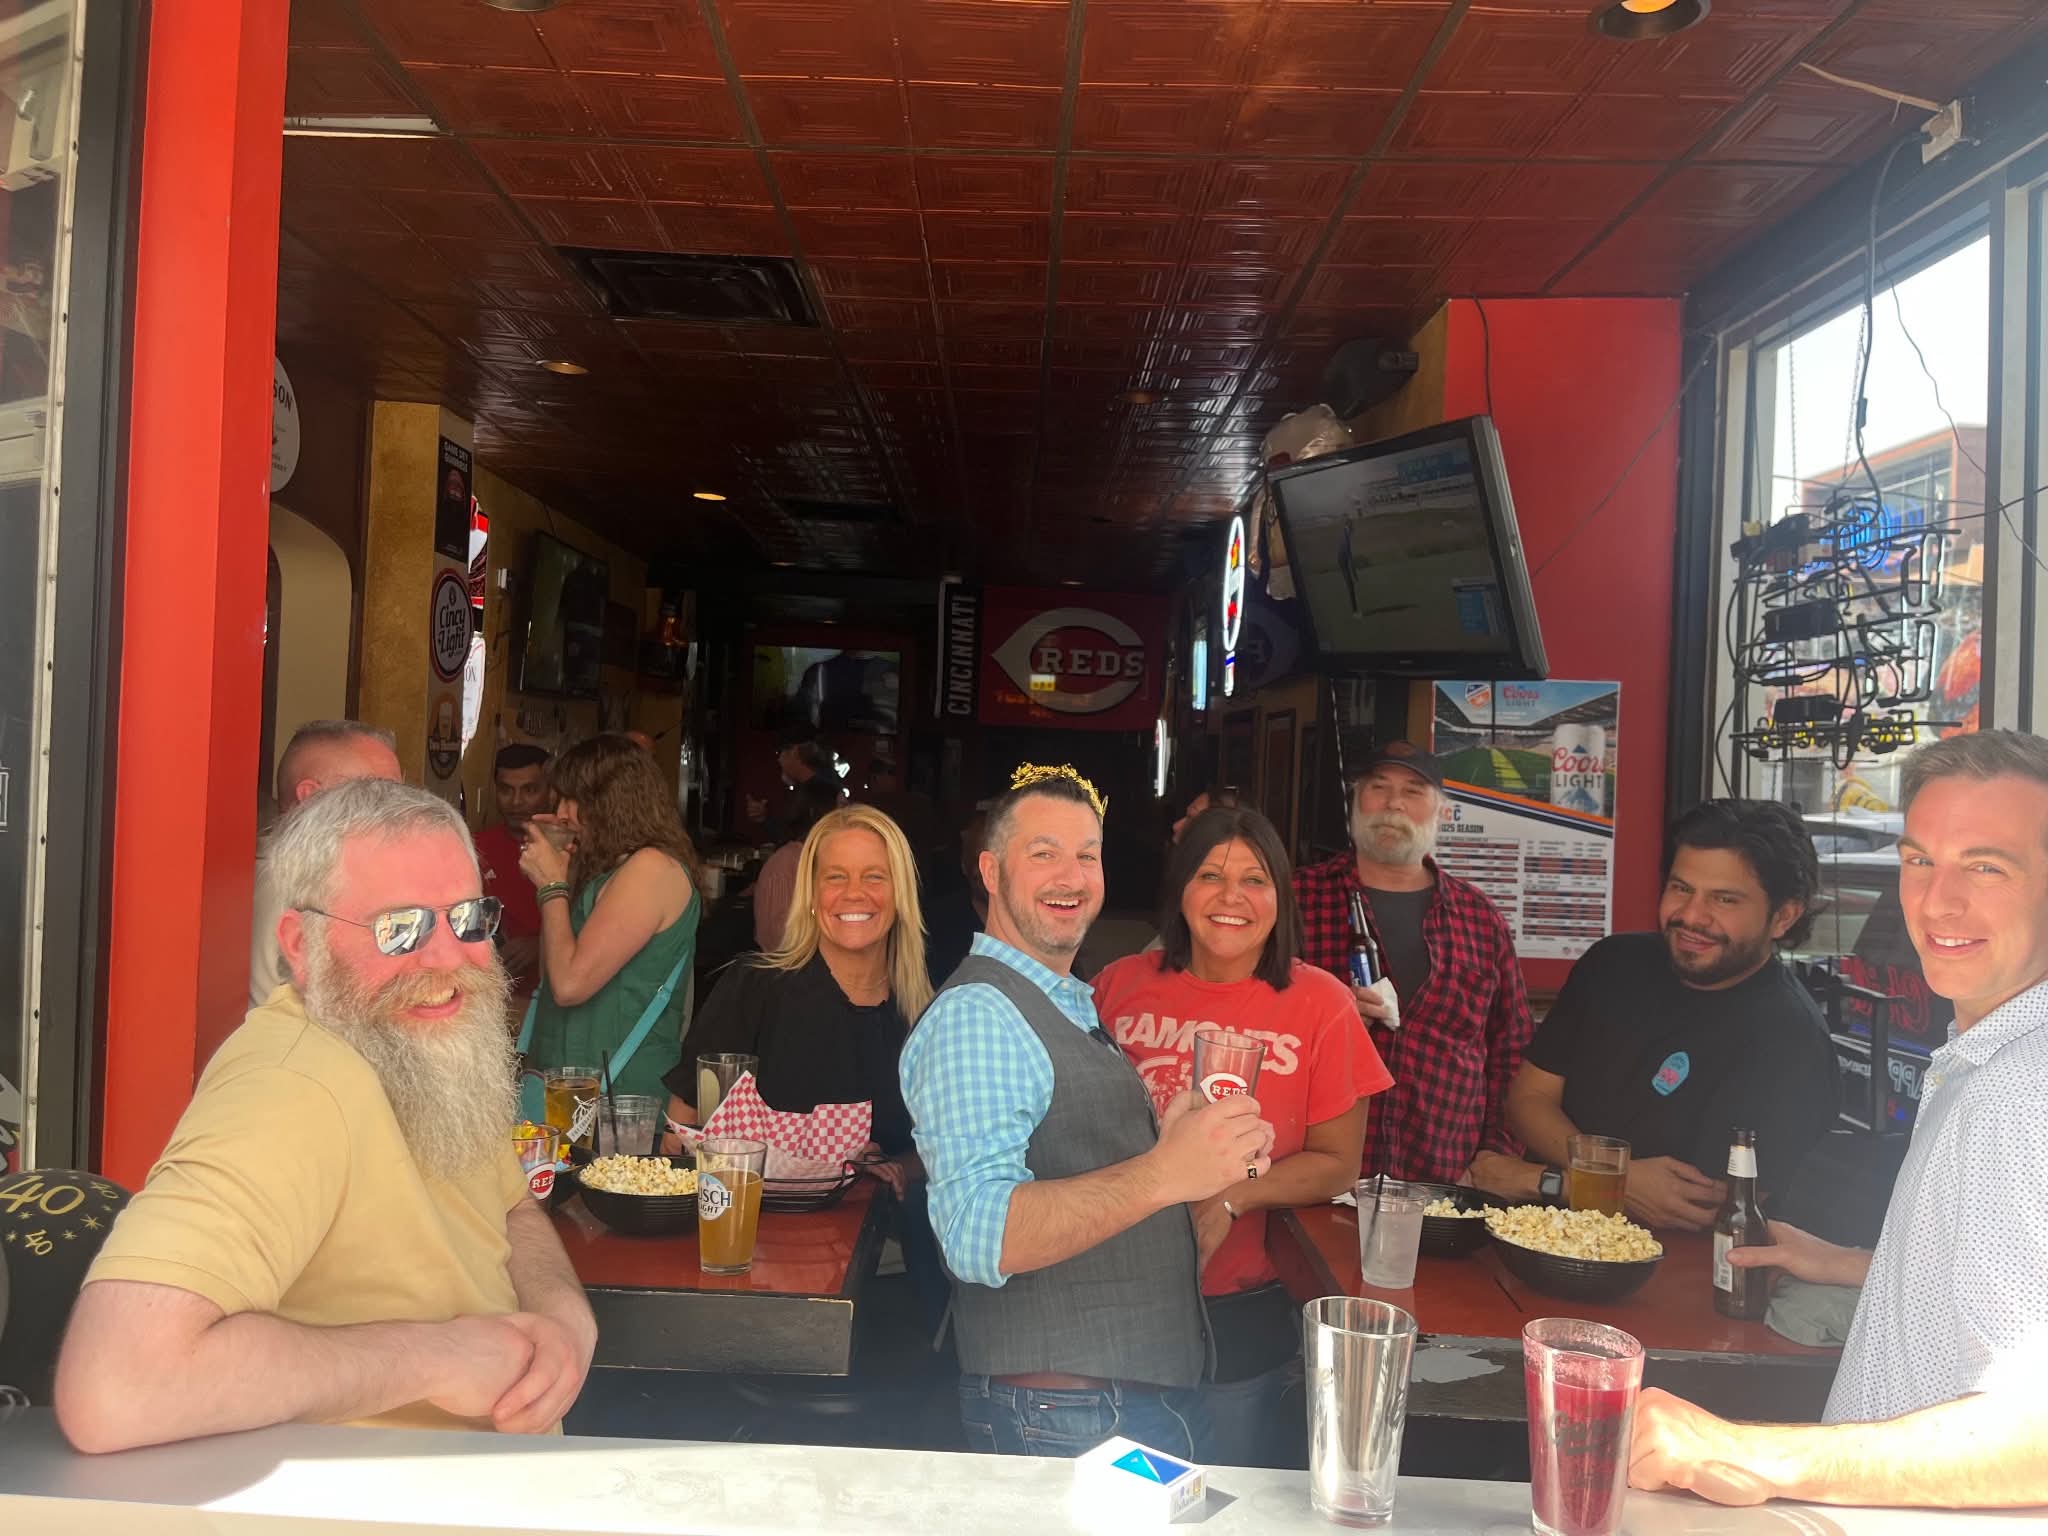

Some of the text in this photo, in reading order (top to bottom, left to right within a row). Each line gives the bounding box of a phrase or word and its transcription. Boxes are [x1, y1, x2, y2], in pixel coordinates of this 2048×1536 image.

[439, 605, 466, 630] Cincy
[438, 627, 466, 657] Light
[947, 594, 977, 715] CINCINNATI
[1038, 647, 1146, 677] REDS
[1555, 774, 1603, 788] LIGHT
[1456, 824, 1484, 834] SEASON
[0, 1175, 85, 1215] 40
[90, 1181, 119, 1200] 40
[532, 1175, 554, 1189] RED
[24, 1229, 53, 1256] 40
